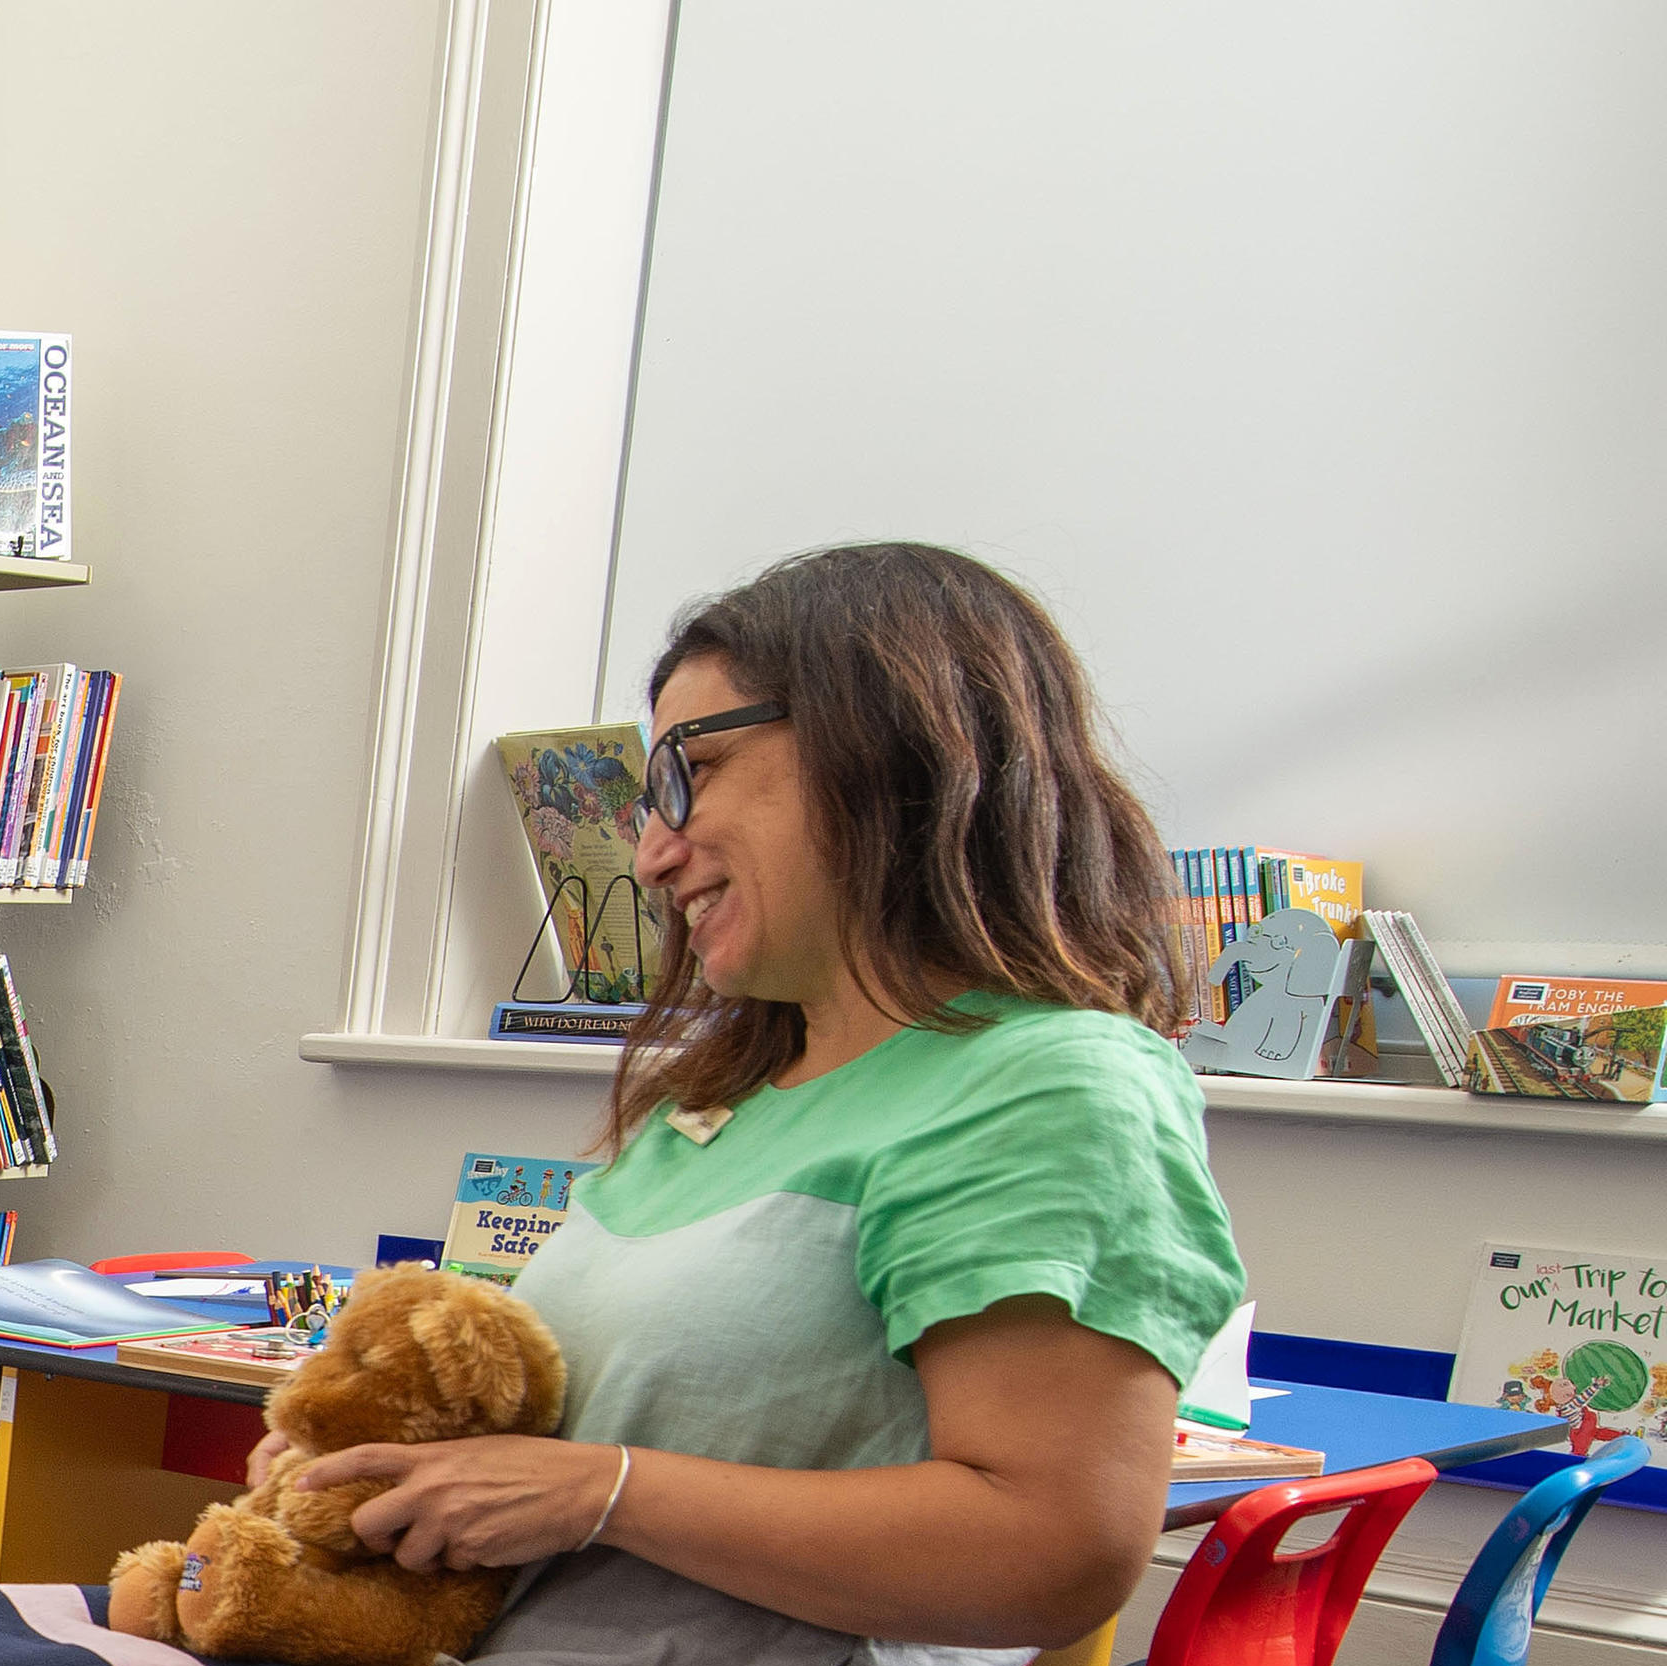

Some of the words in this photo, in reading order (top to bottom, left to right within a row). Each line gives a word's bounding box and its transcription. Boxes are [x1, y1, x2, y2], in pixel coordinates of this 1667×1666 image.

[41, 345, 67, 469] OCEAN
[42, 472, 64, 480] AND
[40, 483, 63, 550] SEA
[63, 672, 72, 690] The
[55, 711, 65, 736] book
[52, 738, 61, 753] for
[45, 755, 57, 795] children
[1305, 868, 1347, 895] Broke
[1546, 987, 1590, 1002] TOBY
[1594, 990, 1625, 1003] THE
[524, 1016, 558, 1028] WHAT
[557, 1018, 578, 1029] DO
[584, 1020, 617, 1031] READ
[491, 1234, 539, 1255] Safe
[1536, 1263, 1562, 1274] last
[1500, 1276, 1551, 1310] Our
[1562, 1264, 1627, 1298] Trip
[1639, 1267, 1667, 1299] to
[1548, 1298, 1667, 1338] Market
